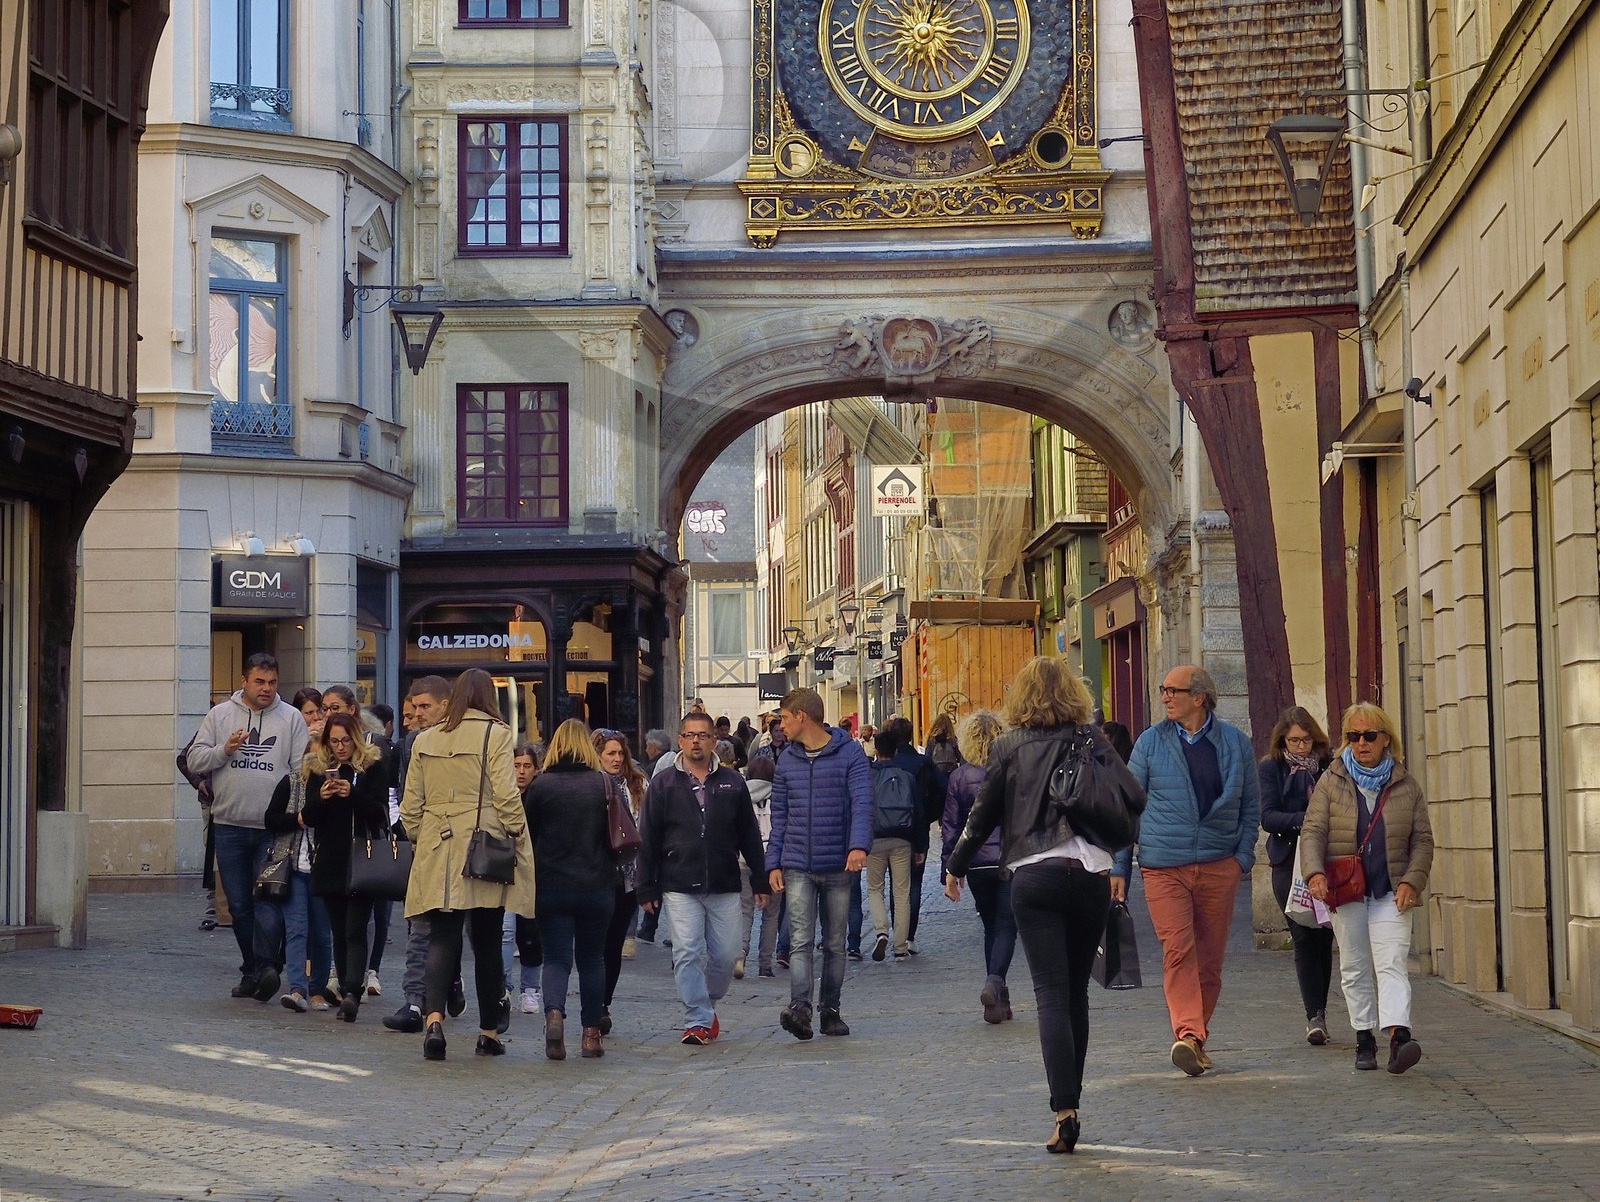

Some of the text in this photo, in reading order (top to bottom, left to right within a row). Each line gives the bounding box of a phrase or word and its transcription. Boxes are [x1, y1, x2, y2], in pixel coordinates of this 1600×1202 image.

[832, 19, 854, 48] IX
[996, 17, 1017, 40] III
[836, 53, 868, 99] VIII
[982, 53, 1013, 88] IIII
[866, 87, 900, 120] VII
[914, 102, 943, 124] VI
[959, 91, 982, 115] V
[417, 633, 533, 649] CALZEDONIA
[230, 758, 274, 772] adidas
[1292, 878, 1303, 905] THE
